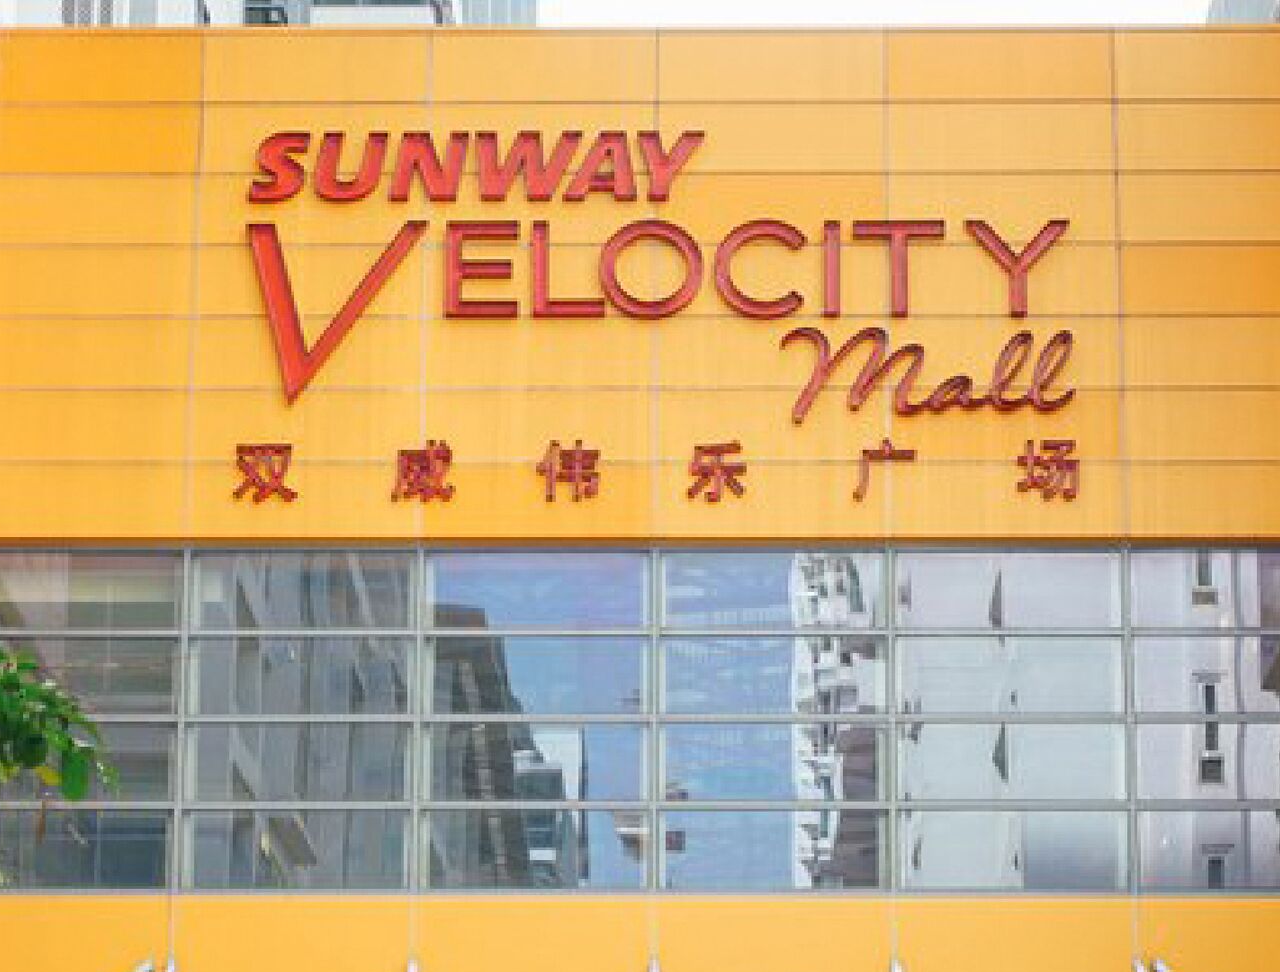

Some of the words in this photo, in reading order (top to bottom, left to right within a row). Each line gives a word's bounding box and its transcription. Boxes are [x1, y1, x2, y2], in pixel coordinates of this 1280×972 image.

[247, 130, 706, 204] SUNWAY
[244, 218, 1072, 406] VELOCITY
[780, 326, 1078, 426] Mall
[232, 438, 1083, 504] 双威伟乐广场
